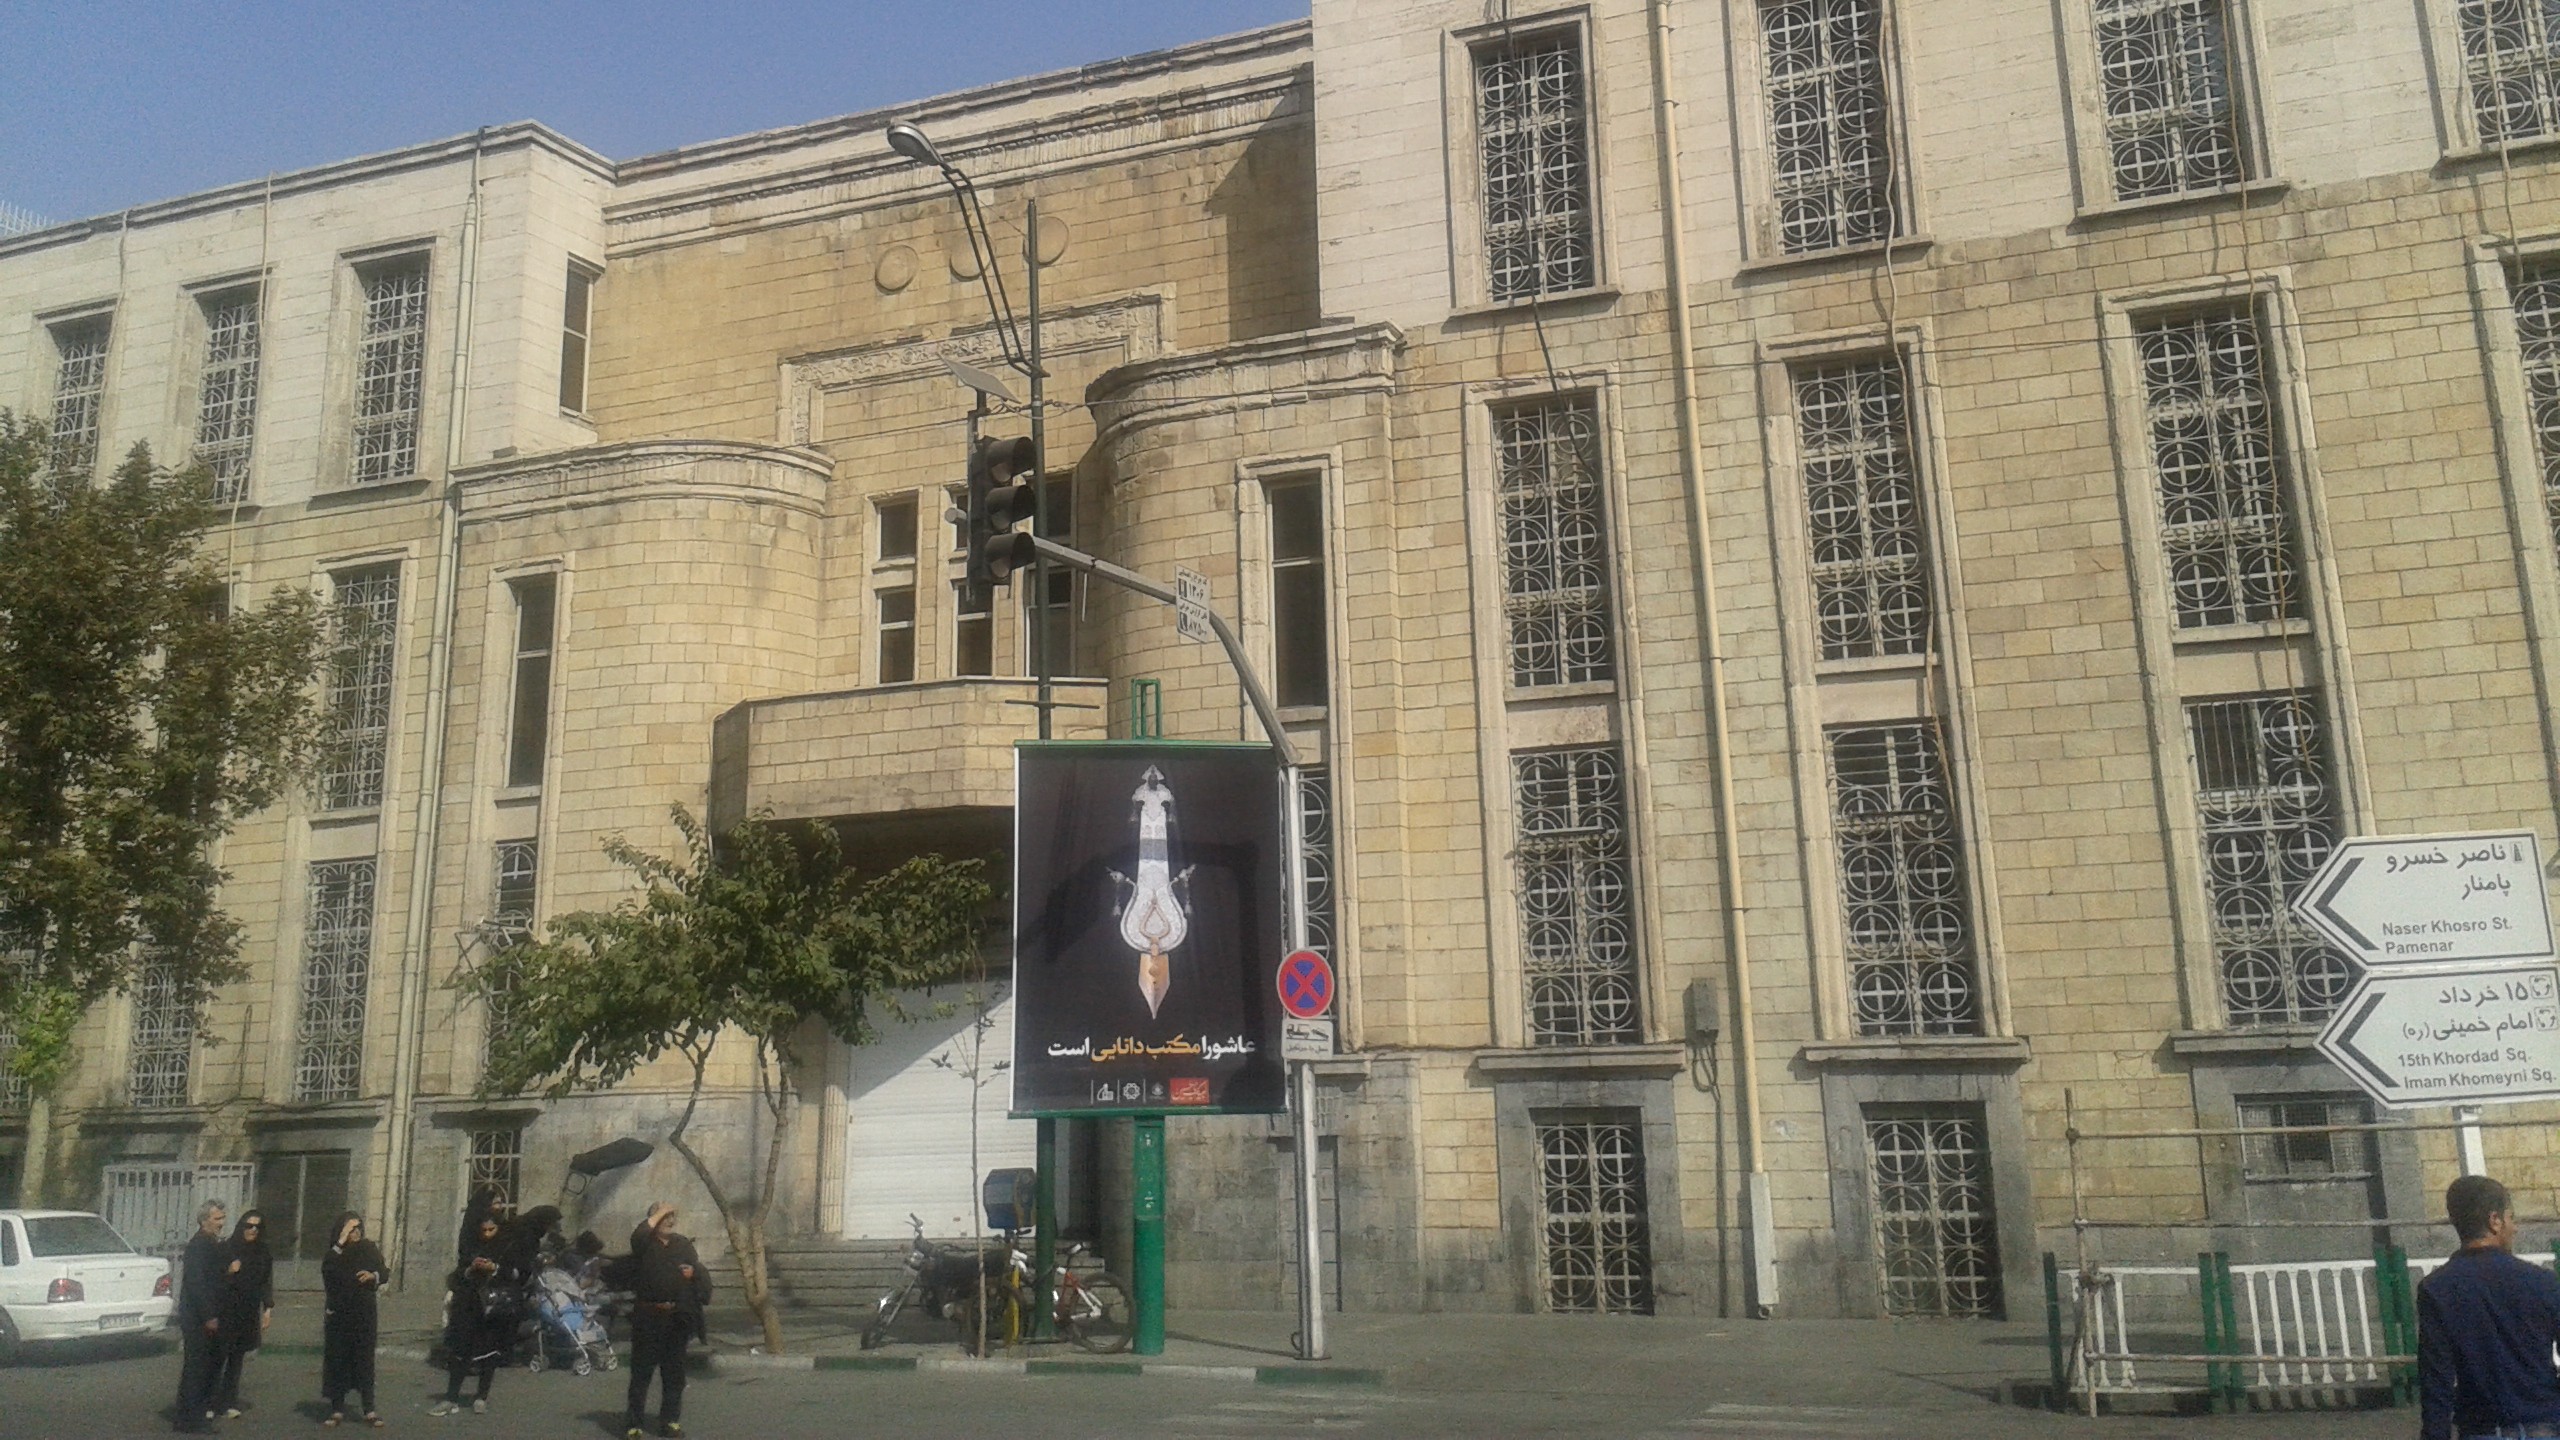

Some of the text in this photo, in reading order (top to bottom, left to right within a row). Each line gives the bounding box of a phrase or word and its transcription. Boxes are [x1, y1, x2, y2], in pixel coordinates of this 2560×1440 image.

[2386, 843, 2507, 873] ناصر خسرو
[2461, 873, 2511, 900] پامنار
[2382, 916, 2513, 936] Naser Khosro St.
[2385, 940, 2454, 954] Pamenar
[2438, 982, 2529, 1007] ۱۵ خرداد
[2432, 1021, 2491, 1041] خمینی
[2495, 1012, 2534, 1041] امام
[1047, 1033, 1256, 1062] عاشورا مکتب دانایی است
[2398, 1047, 2532, 1067] 15th Khordad Sq.
[2404, 1067, 2557, 1089] Imam Khomeyni Sq.
